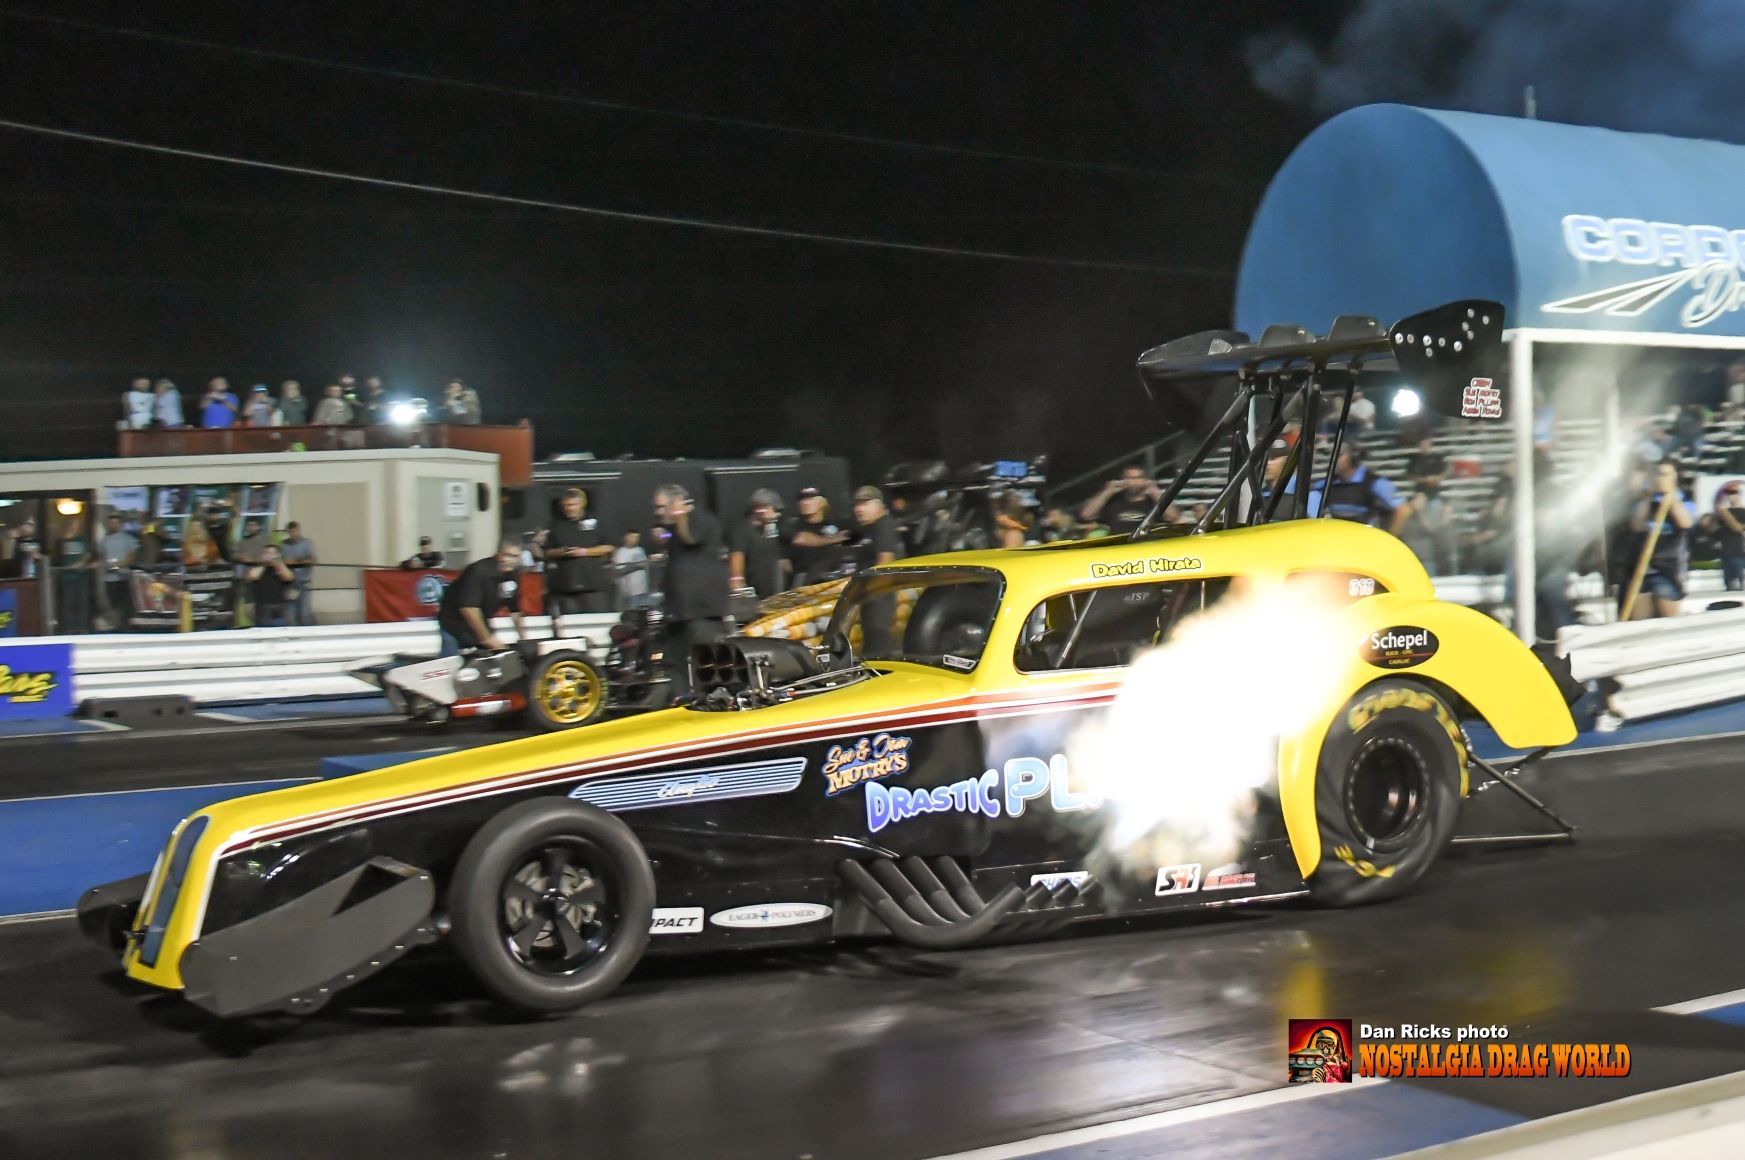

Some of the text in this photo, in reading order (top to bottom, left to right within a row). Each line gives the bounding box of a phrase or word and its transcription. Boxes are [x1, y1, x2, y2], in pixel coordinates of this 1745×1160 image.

[1092, 557, 1201, 578] David Hirata
[1371, 629, 1428, 650] Schepel
[865, 769, 1001, 833] DRASTIC
